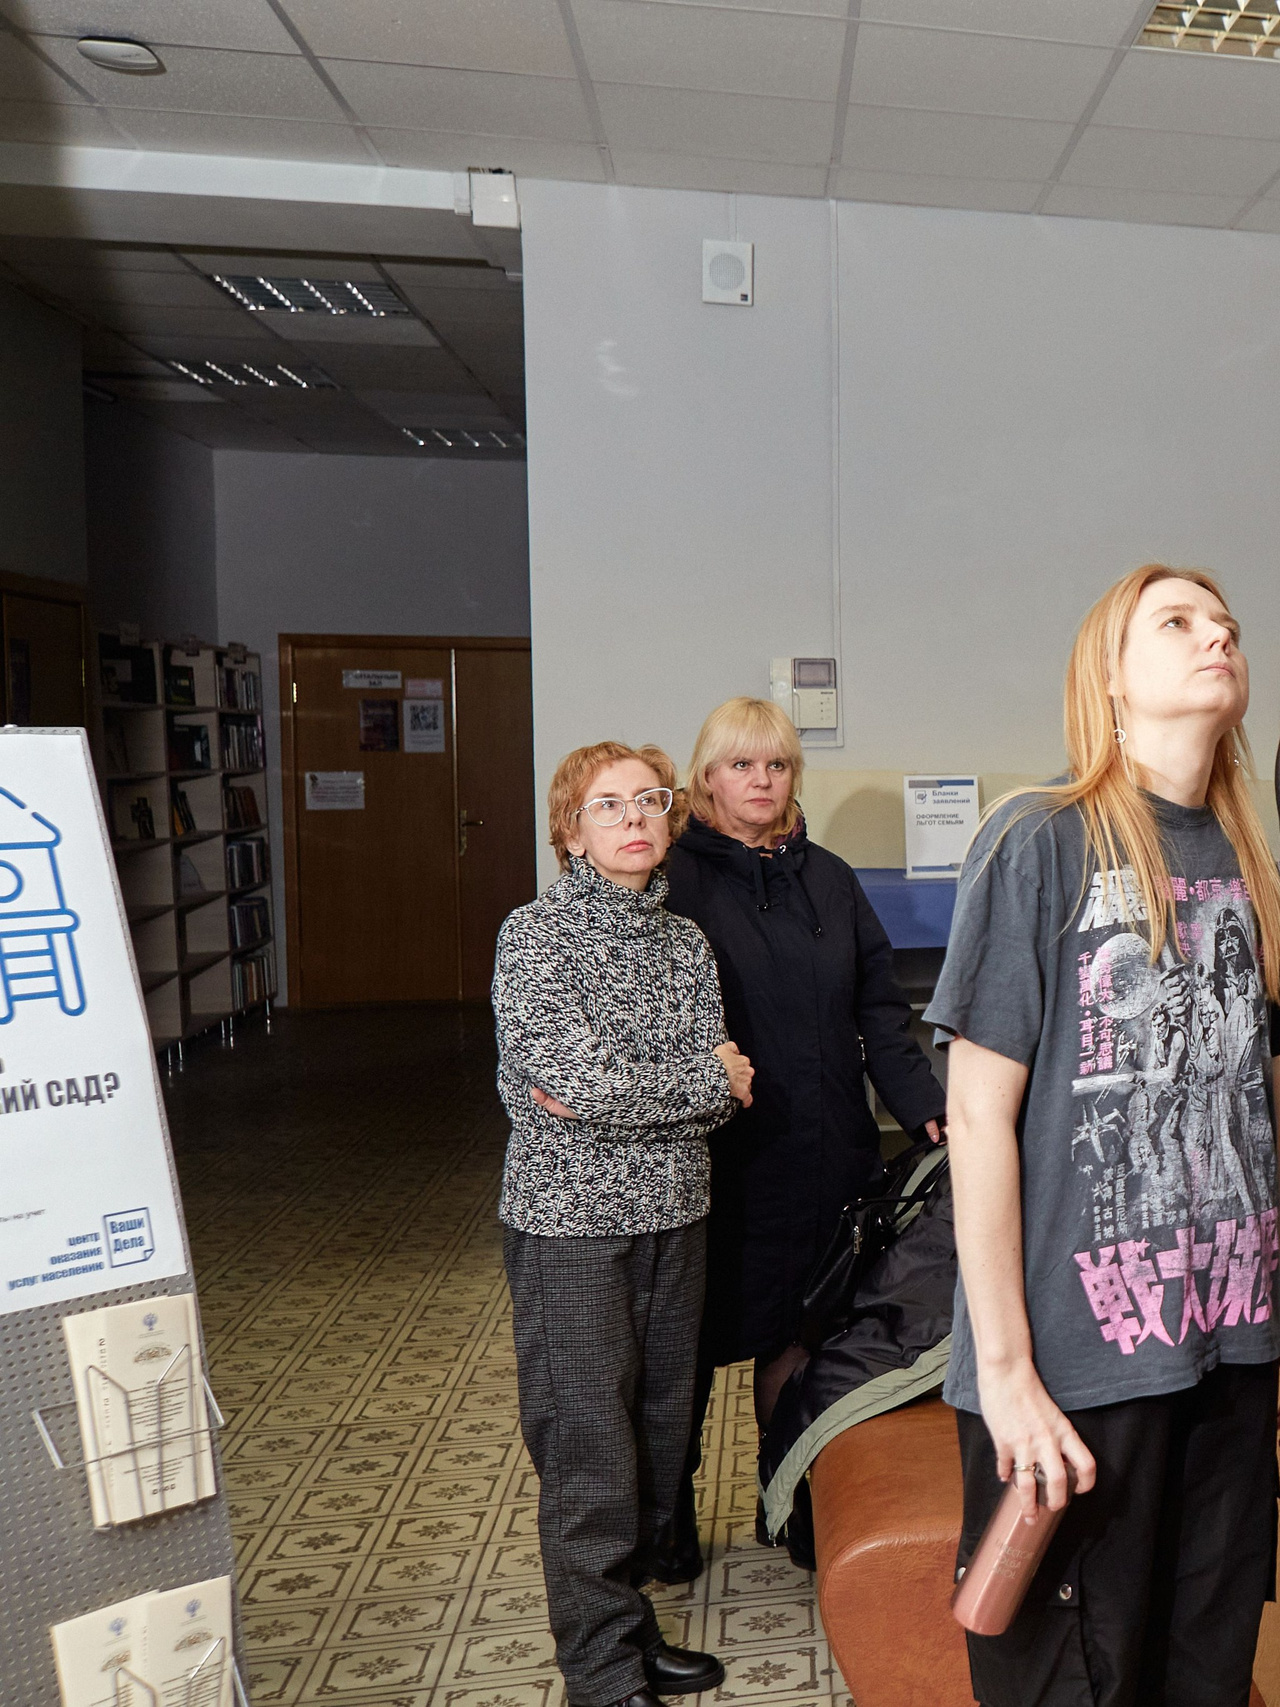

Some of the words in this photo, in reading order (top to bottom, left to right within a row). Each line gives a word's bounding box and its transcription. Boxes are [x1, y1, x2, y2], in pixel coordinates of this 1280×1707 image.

[46, 1071, 121, 1108] САД?
[109, 1216, 145, 1234] Ваши
[68, 1231, 100, 1247] центр
[113, 1234, 145, 1254] Дела
[50, 1246, 103, 1265] оказания
[8, 1273, 40, 1291] услуг
[41, 1261, 105, 1283] населению
